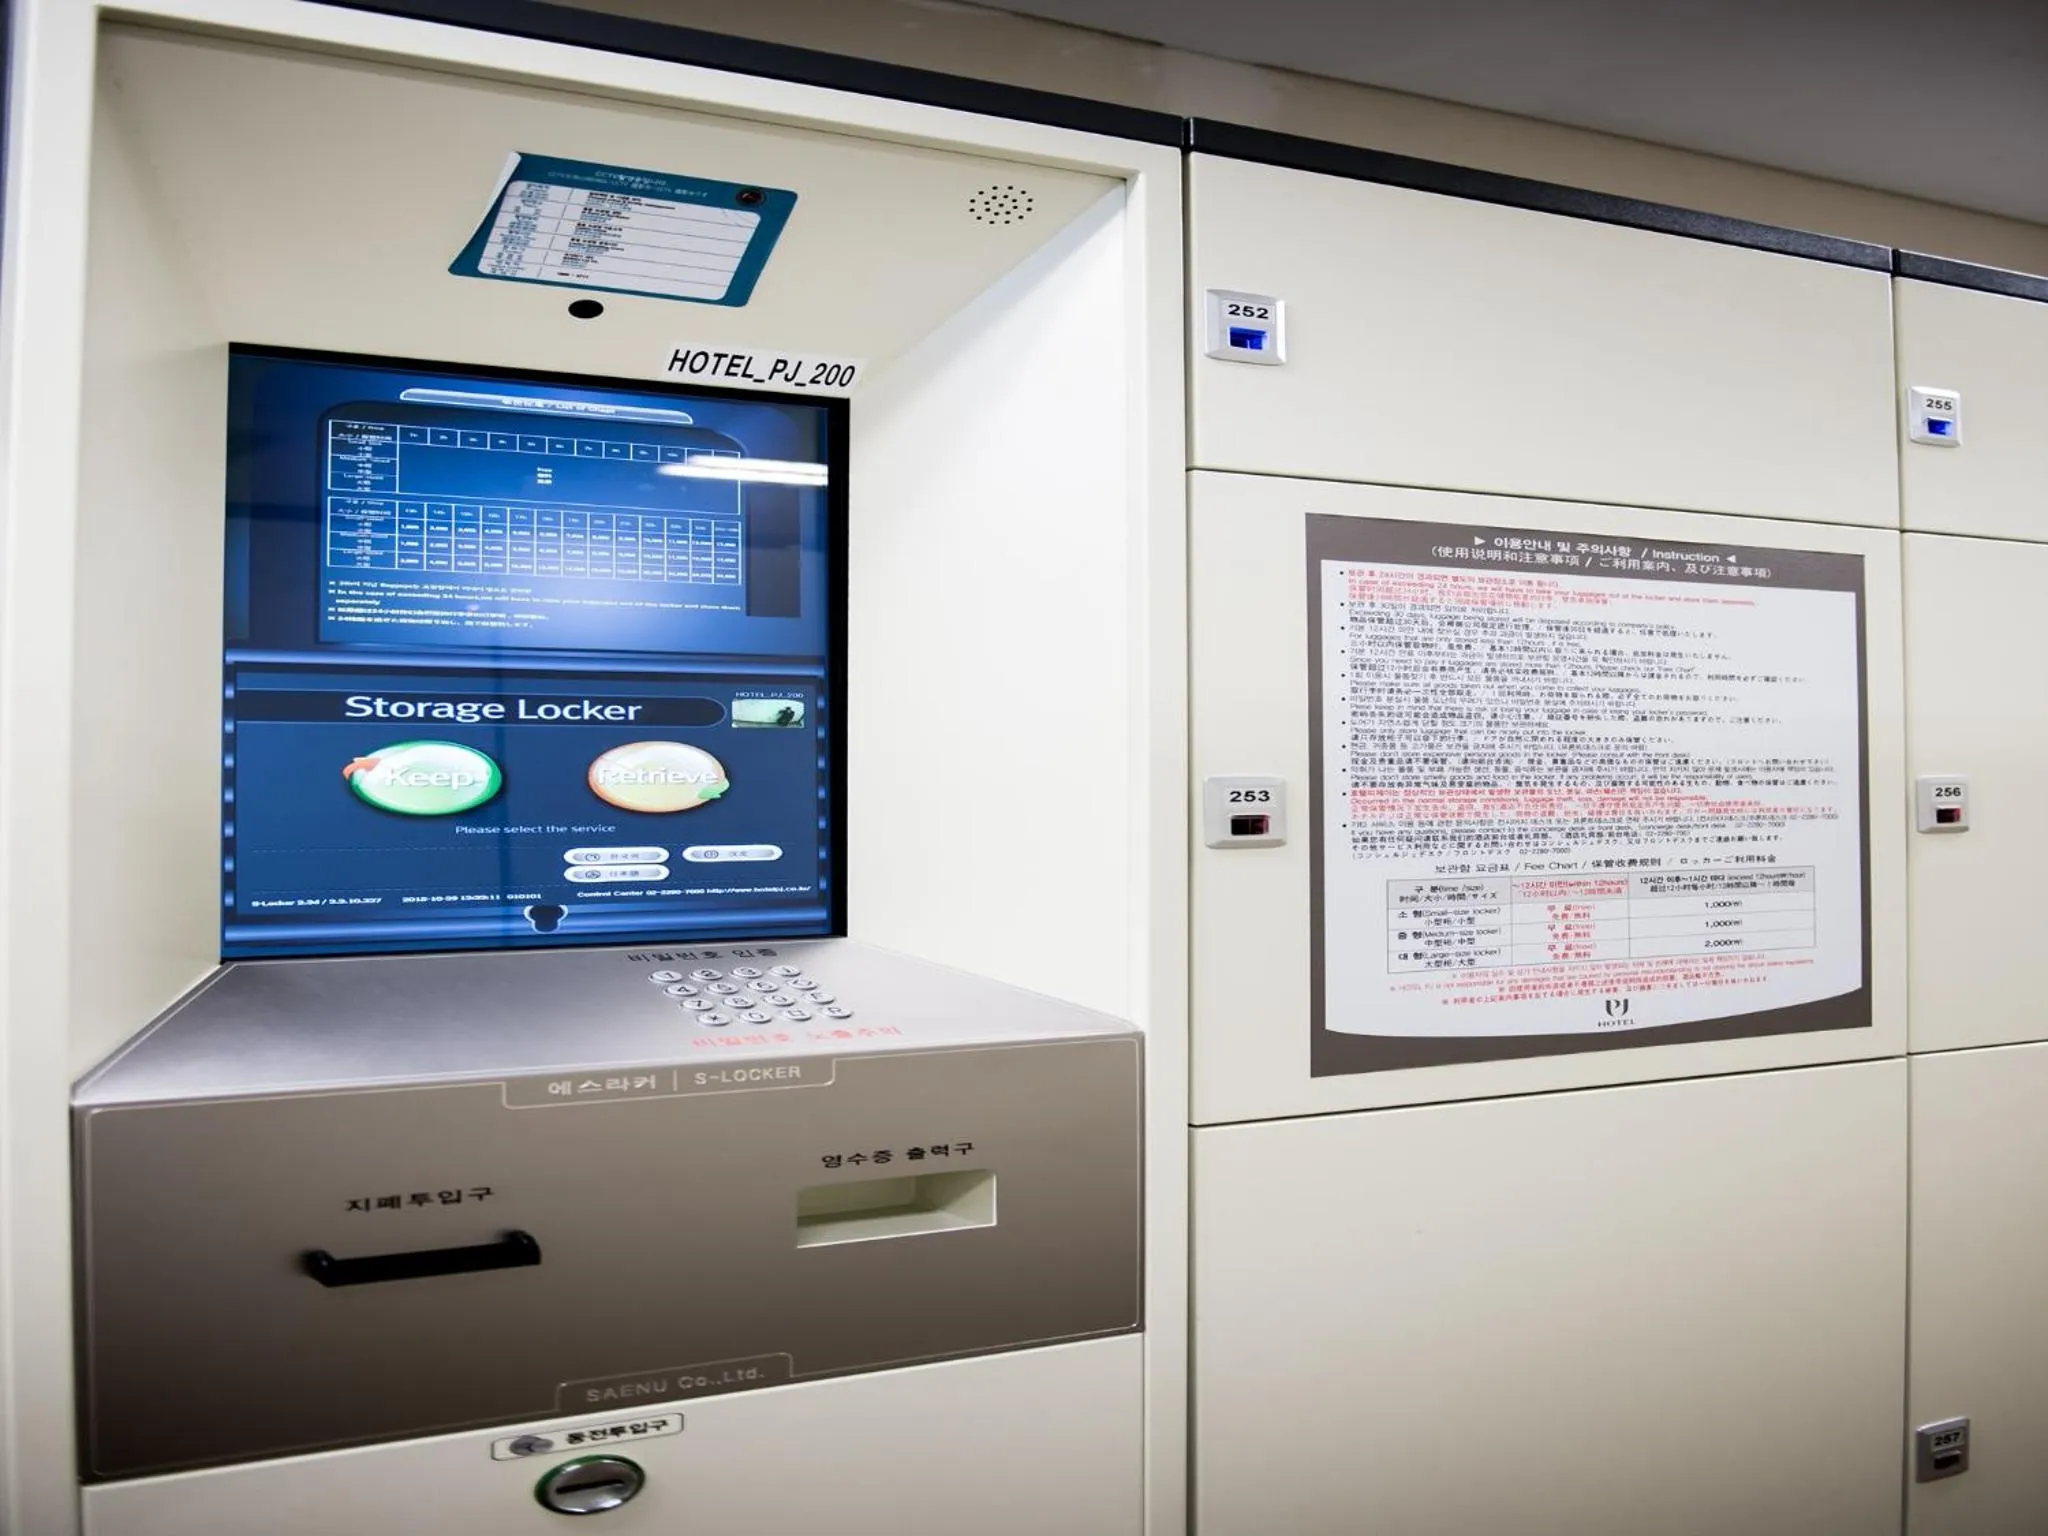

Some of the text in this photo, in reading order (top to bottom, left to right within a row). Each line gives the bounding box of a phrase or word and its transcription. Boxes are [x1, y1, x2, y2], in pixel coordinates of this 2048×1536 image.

[1227, 303, 1269, 320] 252
[668, 347, 857, 389] HOTEL_PJ_200
[1925, 398, 1953, 411] 255
[1494, 536, 1551, 551] 이용안내
[1576, 542, 1632, 558] 주의사항
[1652, 549, 1720, 563] Instruction
[345, 696, 642, 723] Storage Locker
[386, 766, 476, 790] Keep
[597, 766, 719, 786] Retrieve
[1229, 790, 1270, 803] 253
[1935, 787, 1962, 797] 256
[455, 824, 616, 835] Please select the service
[1435, 863, 1470, 874] 보관함
[1475, 862, 1510, 873] 요금표
[1524, 861, 1545, 870] Fee
[1549, 860, 1578, 870] Chart
[548, 1065, 801, 1096] 에스라커 S-LOCKER
[821, 1143, 976, 1169] 영수증 출력구
[345, 1186, 497, 1214] 지폐투입구
[586, 1379, 669, 1403] SAENU
